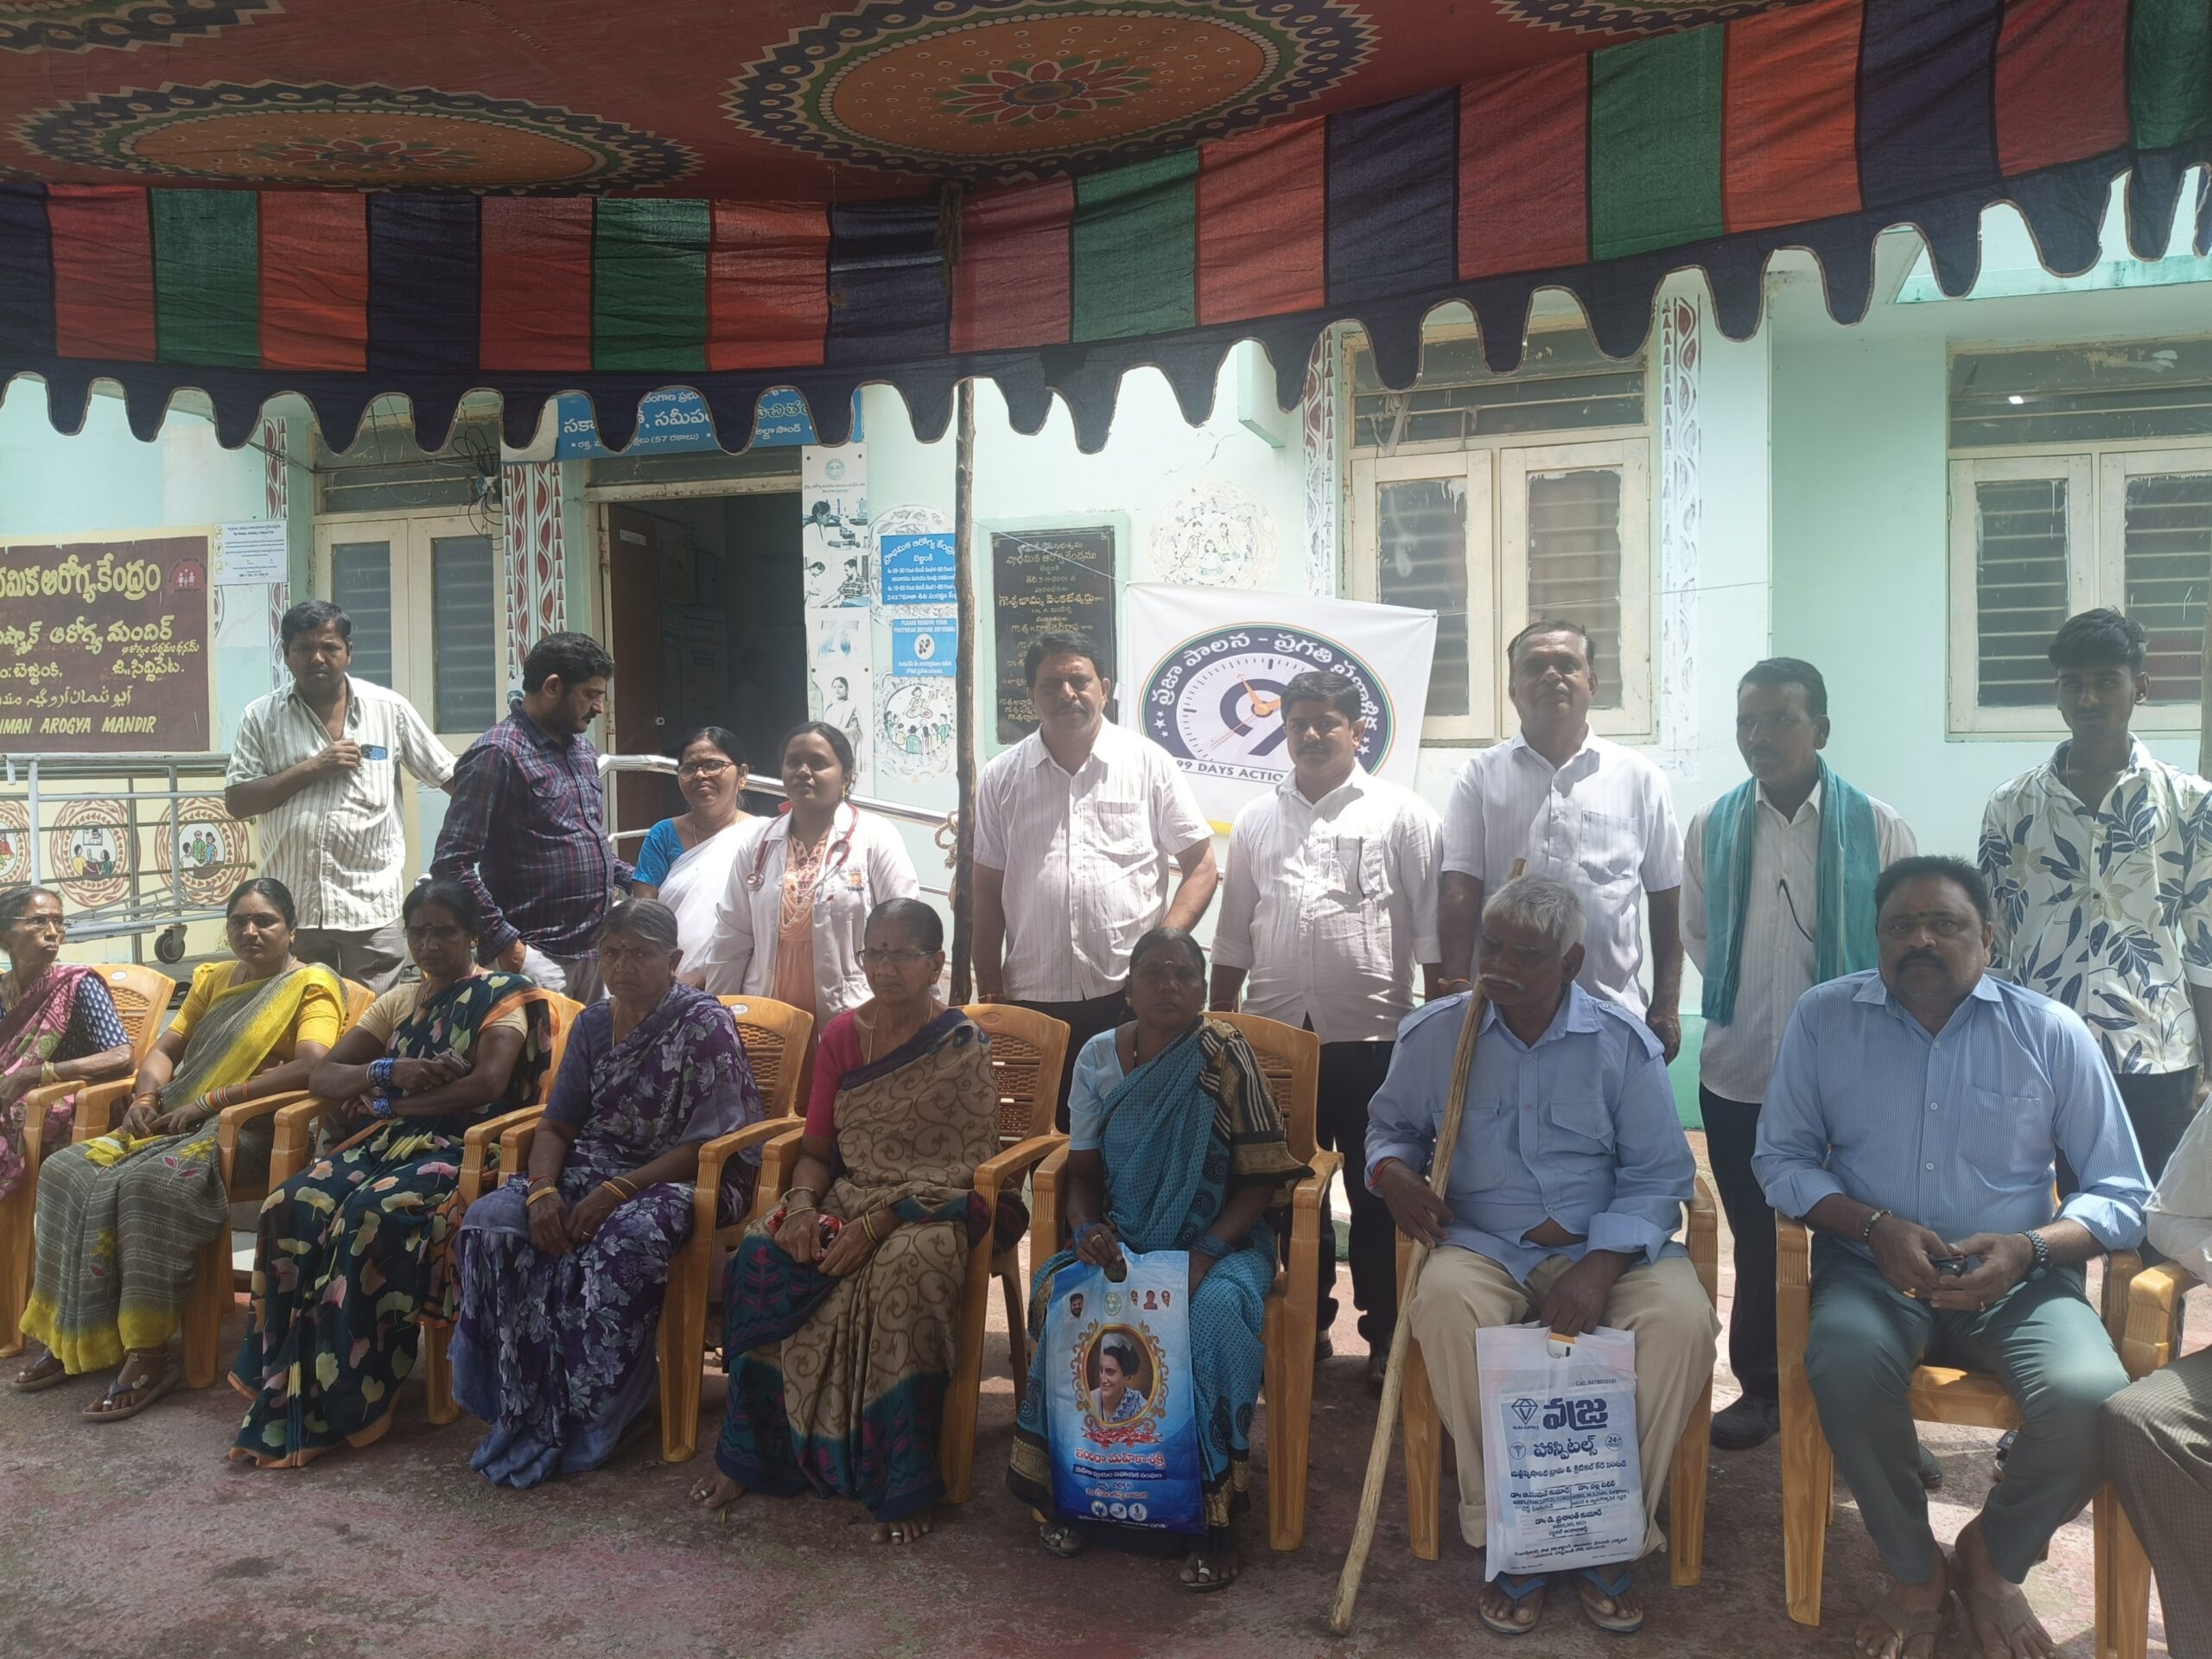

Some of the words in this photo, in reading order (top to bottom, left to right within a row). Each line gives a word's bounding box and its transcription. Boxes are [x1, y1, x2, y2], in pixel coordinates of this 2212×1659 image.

[564, 418, 595, 433] సకా
[41, 554, 98, 603] ఆరోగ్య
[96, 552, 162, 601] కేంద్రం
[49, 615, 104, 655] ఆరోగ్య
[107, 614, 175, 643] మందిర్
[1151, 664, 1183, 705] ప్రజా
[1183, 632, 1251, 668] పాలన
[1274, 632, 1332, 664] ప్రగతి
[40, 716, 92, 735] AROGYA
[101, 715, 157, 734] MANDIR
[1198, 763, 1235, 776] DAYS
[1238, 768, 1284, 782] ACTIO
[1542, 1397, 1609, 1431] వజ్ర
[1075, 1446, 1107, 1464] ఇందిరా
[1533, 1434, 1599, 1459] హాస్పిటల్స్
